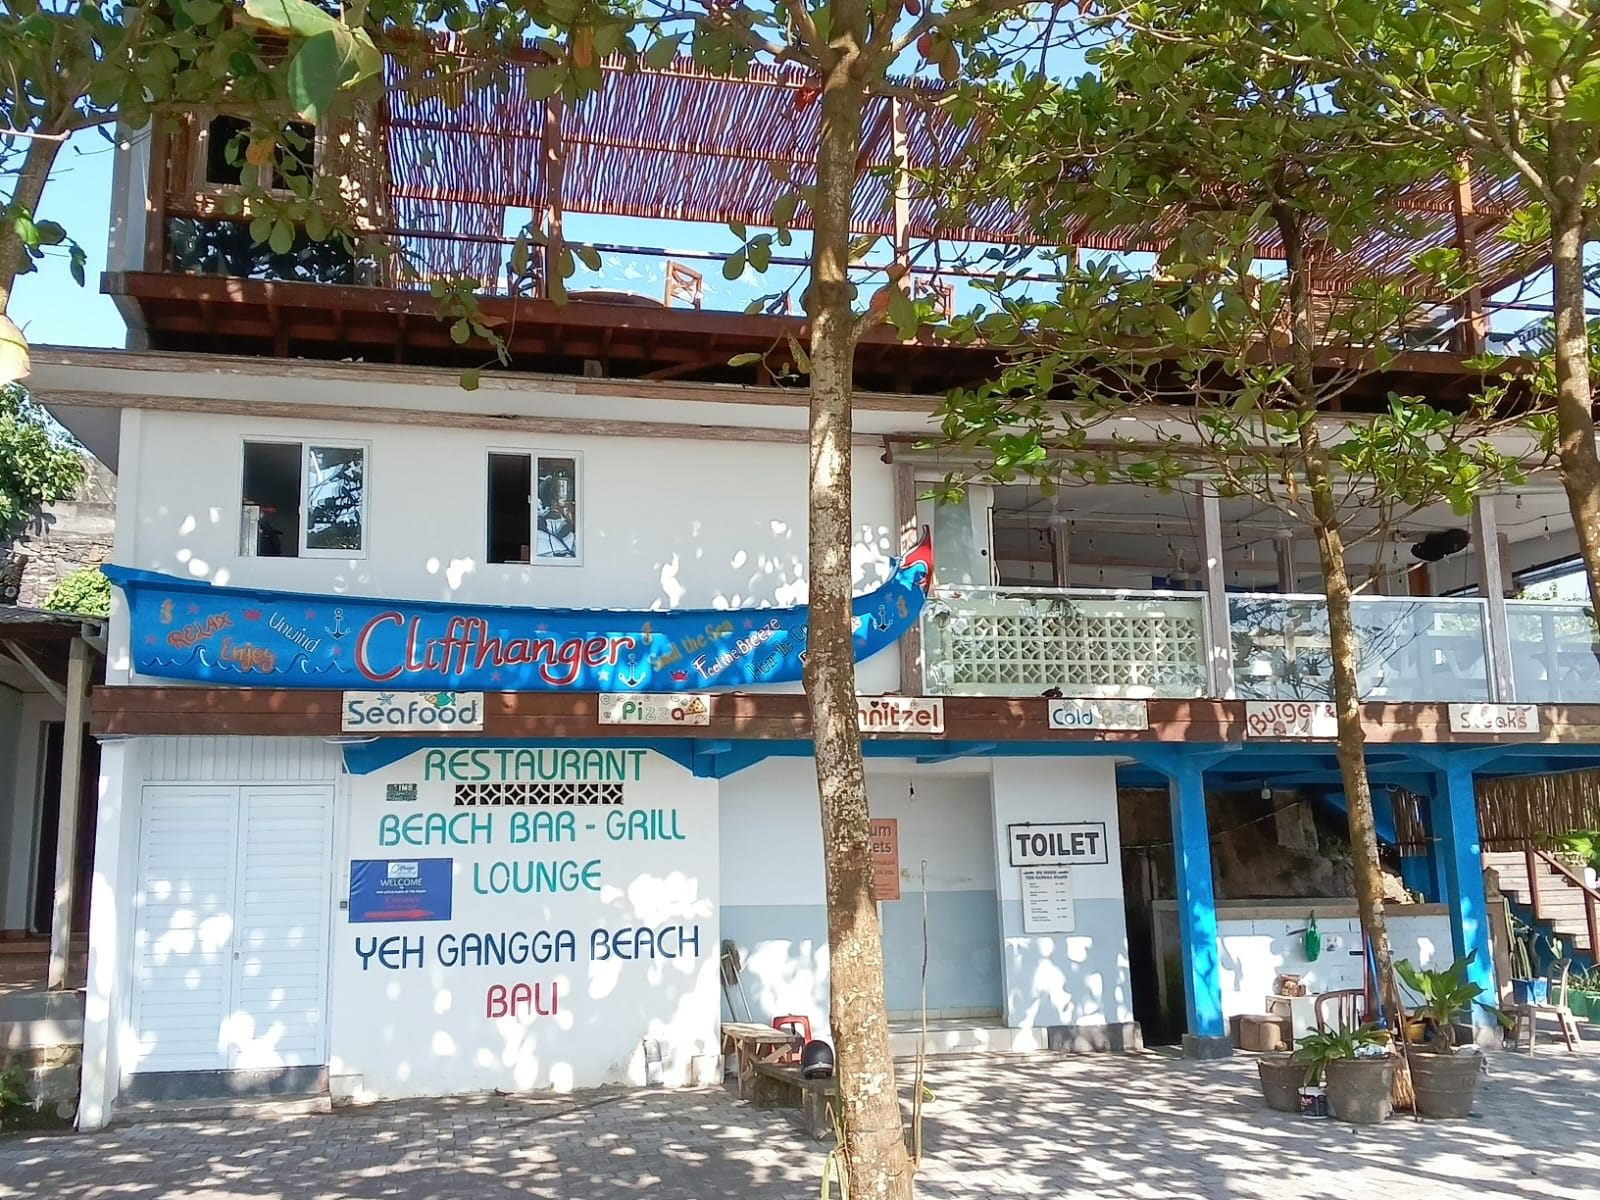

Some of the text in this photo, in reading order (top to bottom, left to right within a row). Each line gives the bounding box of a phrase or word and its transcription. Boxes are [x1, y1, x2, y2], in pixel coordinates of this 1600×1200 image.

[168, 613, 232, 648] RELAX
[268, 611, 321, 653] Unwind
[354, 611, 634, 685] Cliffhanger
[735, 617, 781, 657] Breeze
[220, 637, 276, 674] Enjoy
[347, 701, 478, 726] Seafood
[622, 701, 685, 721] Pizza
[1053, 708, 1093, 725] Cold
[1248, 703, 1320, 735] Burger
[1460, 712, 1528, 730] Seaks
[424, 750, 647, 781] RESTAURANT
[379, 813, 493, 846] BEACH
[510, 811, 576, 844] BAR
[606, 809, 686, 841] GRILL
[1015, 832, 1099, 857] TOILET
[380, 878, 422, 887] WELCOME
[473, 859, 602, 894] LOUNGE
[355, 925, 699, 971] YEH GANGGA BEACH
[486, 981, 558, 1018] BALI
